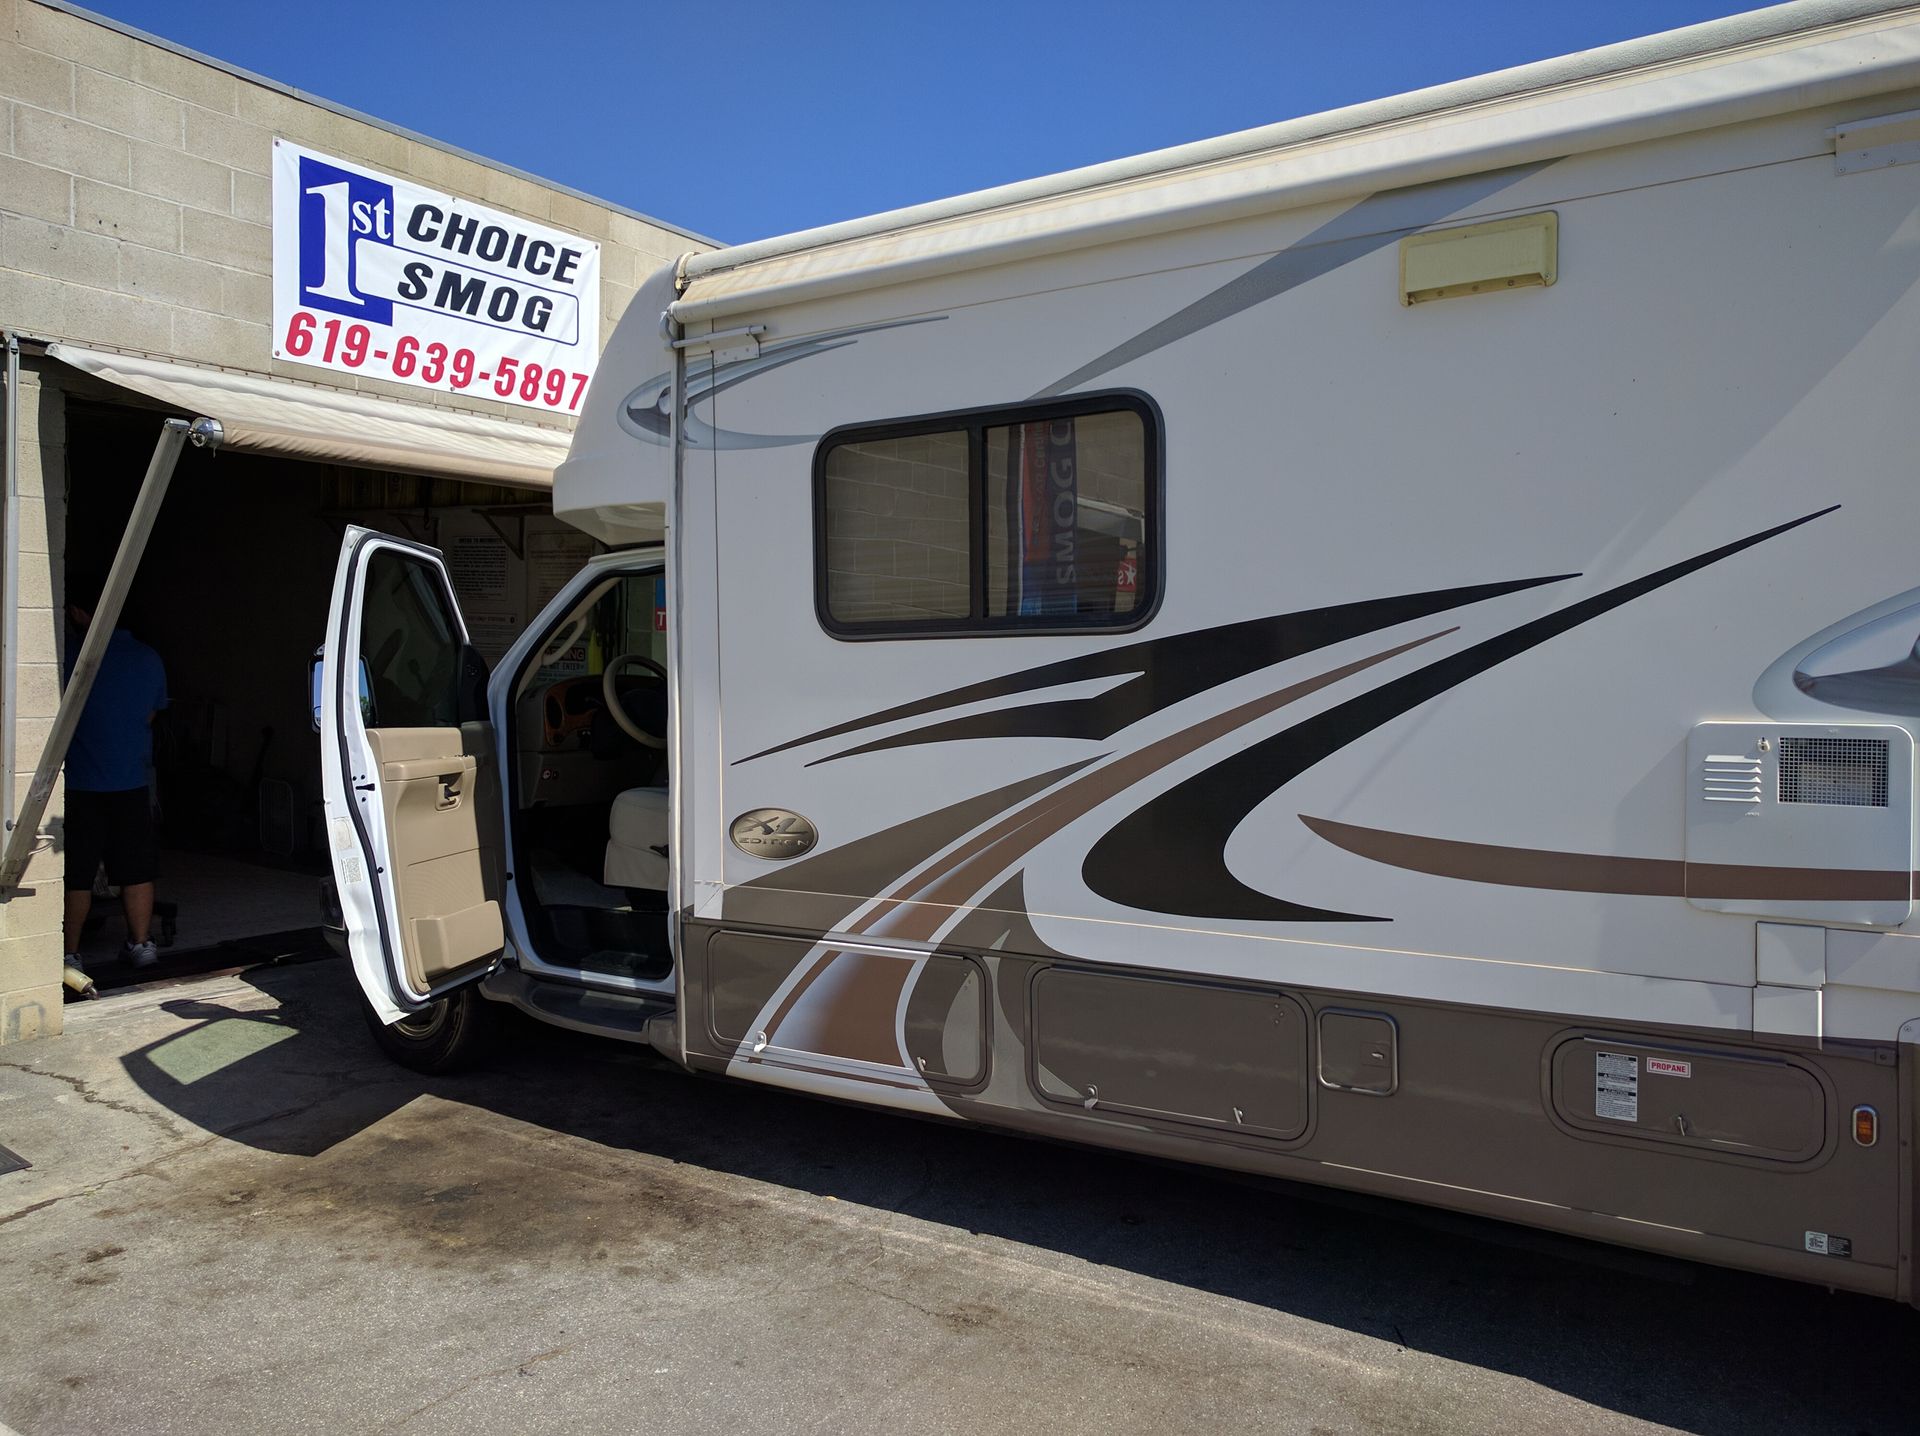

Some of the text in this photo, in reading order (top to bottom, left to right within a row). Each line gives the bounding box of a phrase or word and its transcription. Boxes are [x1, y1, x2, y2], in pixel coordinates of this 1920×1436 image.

[305, 181, 391, 305] 1st
[406, 203, 582, 284] CHOICE
[397, 261, 554, 332] SMOG
[285, 312, 589, 411] 619-639-5897
[1651, 1061, 1687, 1073] PROPANE
